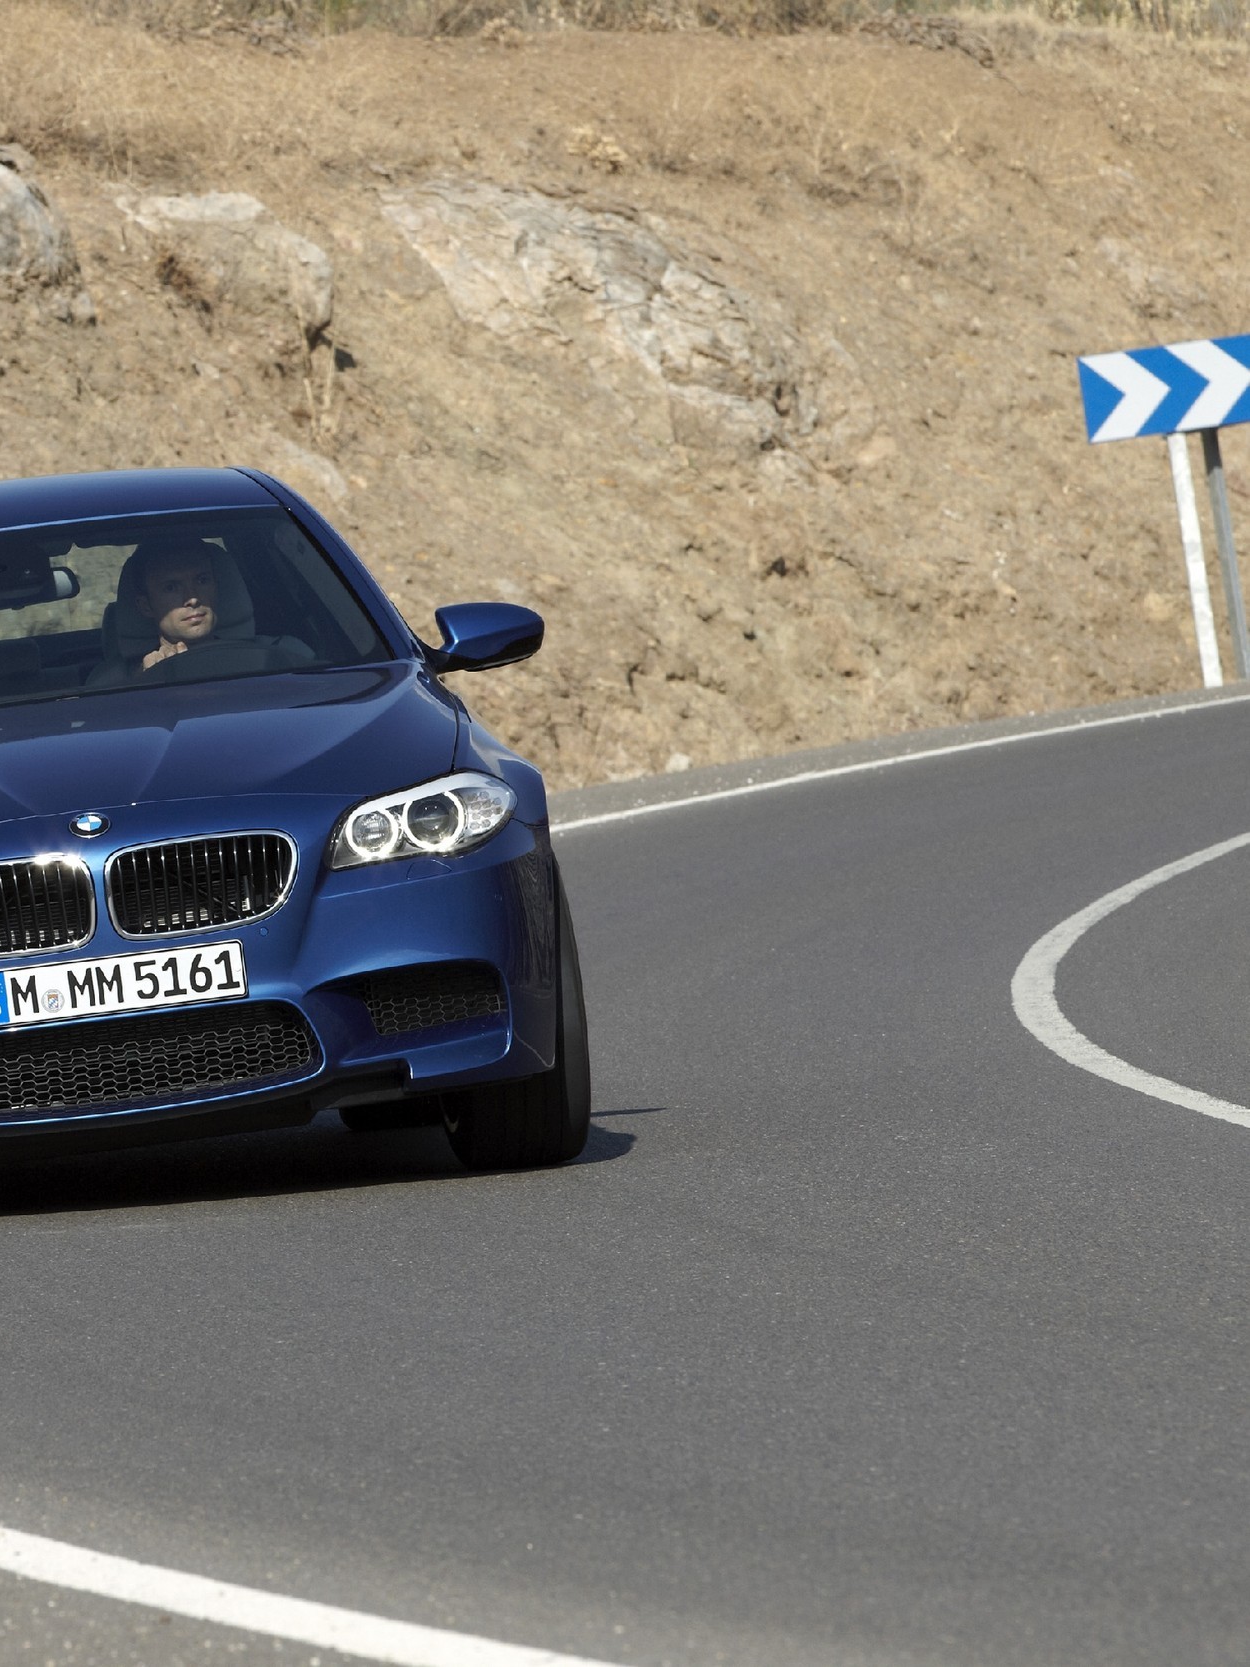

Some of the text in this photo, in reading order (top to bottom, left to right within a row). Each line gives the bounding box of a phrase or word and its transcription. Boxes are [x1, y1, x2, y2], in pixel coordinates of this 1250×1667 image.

[10, 950, 241, 1016] M MM 5161
